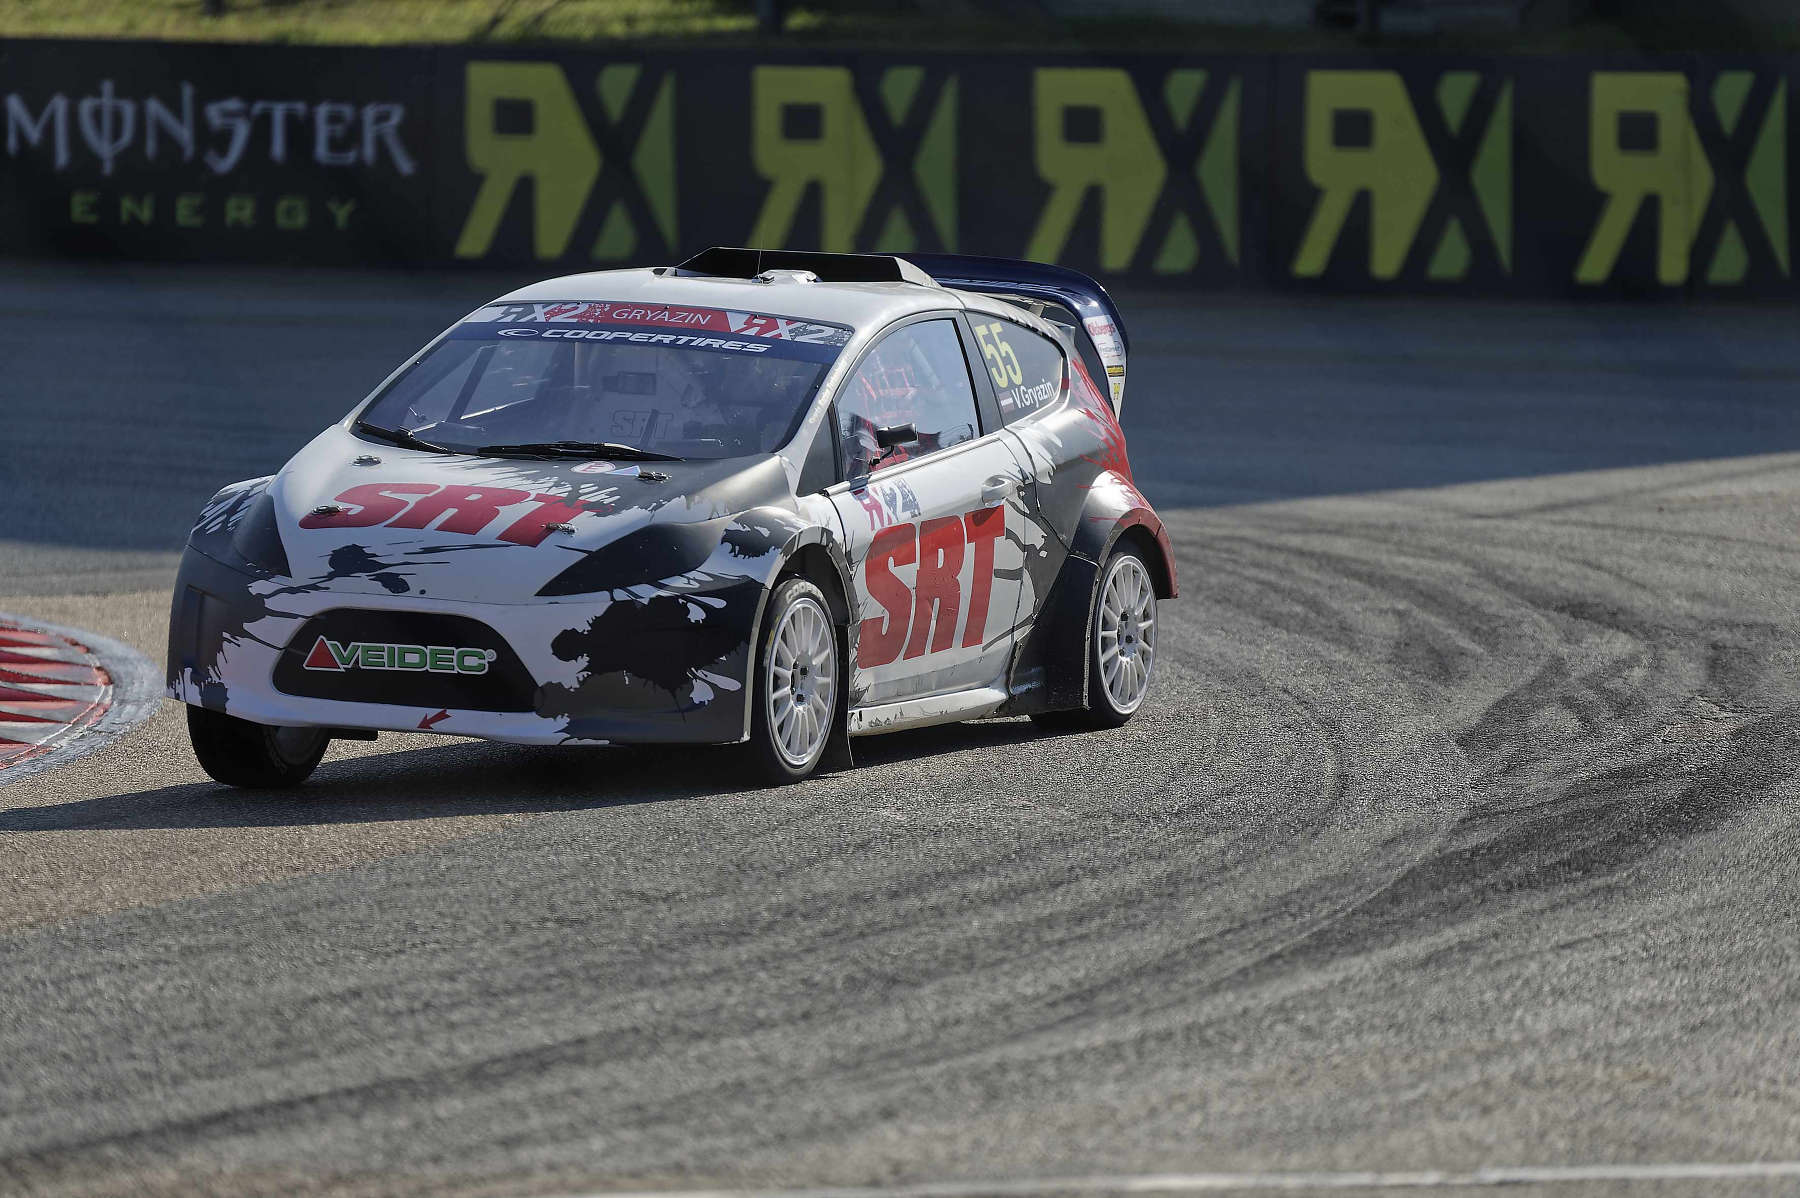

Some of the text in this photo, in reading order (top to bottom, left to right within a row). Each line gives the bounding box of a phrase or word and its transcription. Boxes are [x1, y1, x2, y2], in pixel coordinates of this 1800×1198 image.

[4, 79, 416, 176] MONSTER
[70, 192, 357, 229] ENERGY
[612, 308, 712, 326] GRYAZIN
[975, 322, 1022, 388] 55
[299, 483, 603, 547] SRT
[857, 505, 1006, 670] SRT
